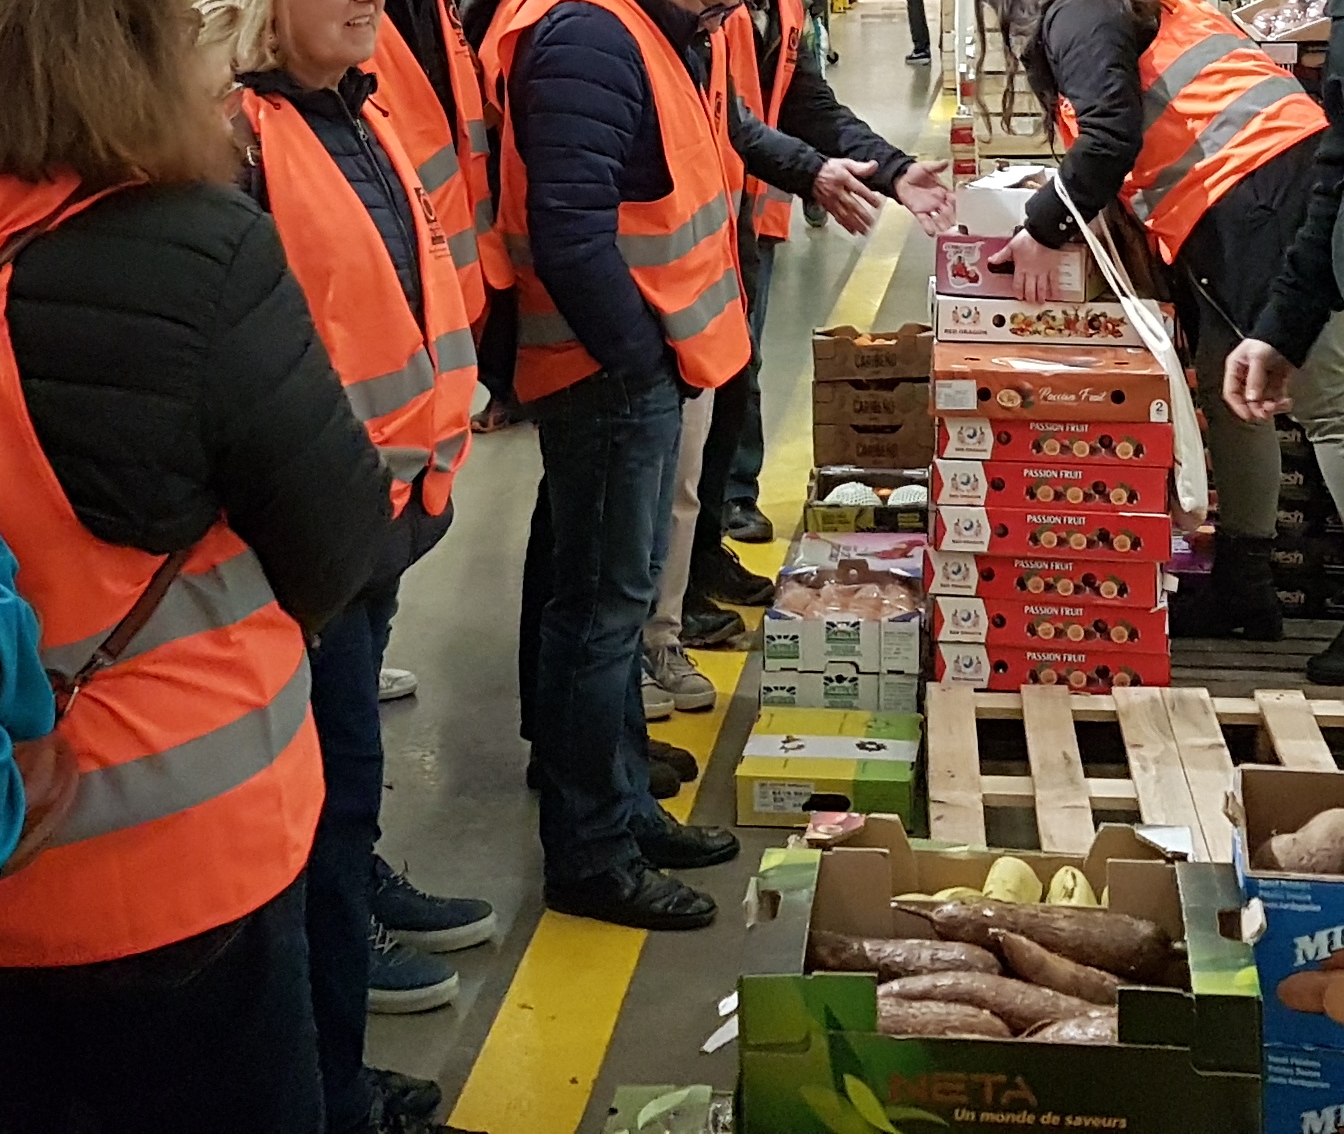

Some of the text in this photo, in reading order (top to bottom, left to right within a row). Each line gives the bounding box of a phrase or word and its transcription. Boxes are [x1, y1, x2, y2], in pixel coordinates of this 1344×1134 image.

[1155, 402, 1164, 413] 2
[1030, 422, 1088, 432] PASSION FRUIT
[1024, 469, 1083, 479] PASSION FRUIT
[1026, 514, 1086, 526] PASSION FRUIT
[1014, 559, 1073, 571] PASSION FRUIT
[1024, 605, 1083, 616] PASSION FRUIT
[1026, 652, 1086, 663] PASSION FRUIT
[888, 1072, 1038, 1108] NETA
[955, 1108, 1127, 1129] Un monde de saveurs
